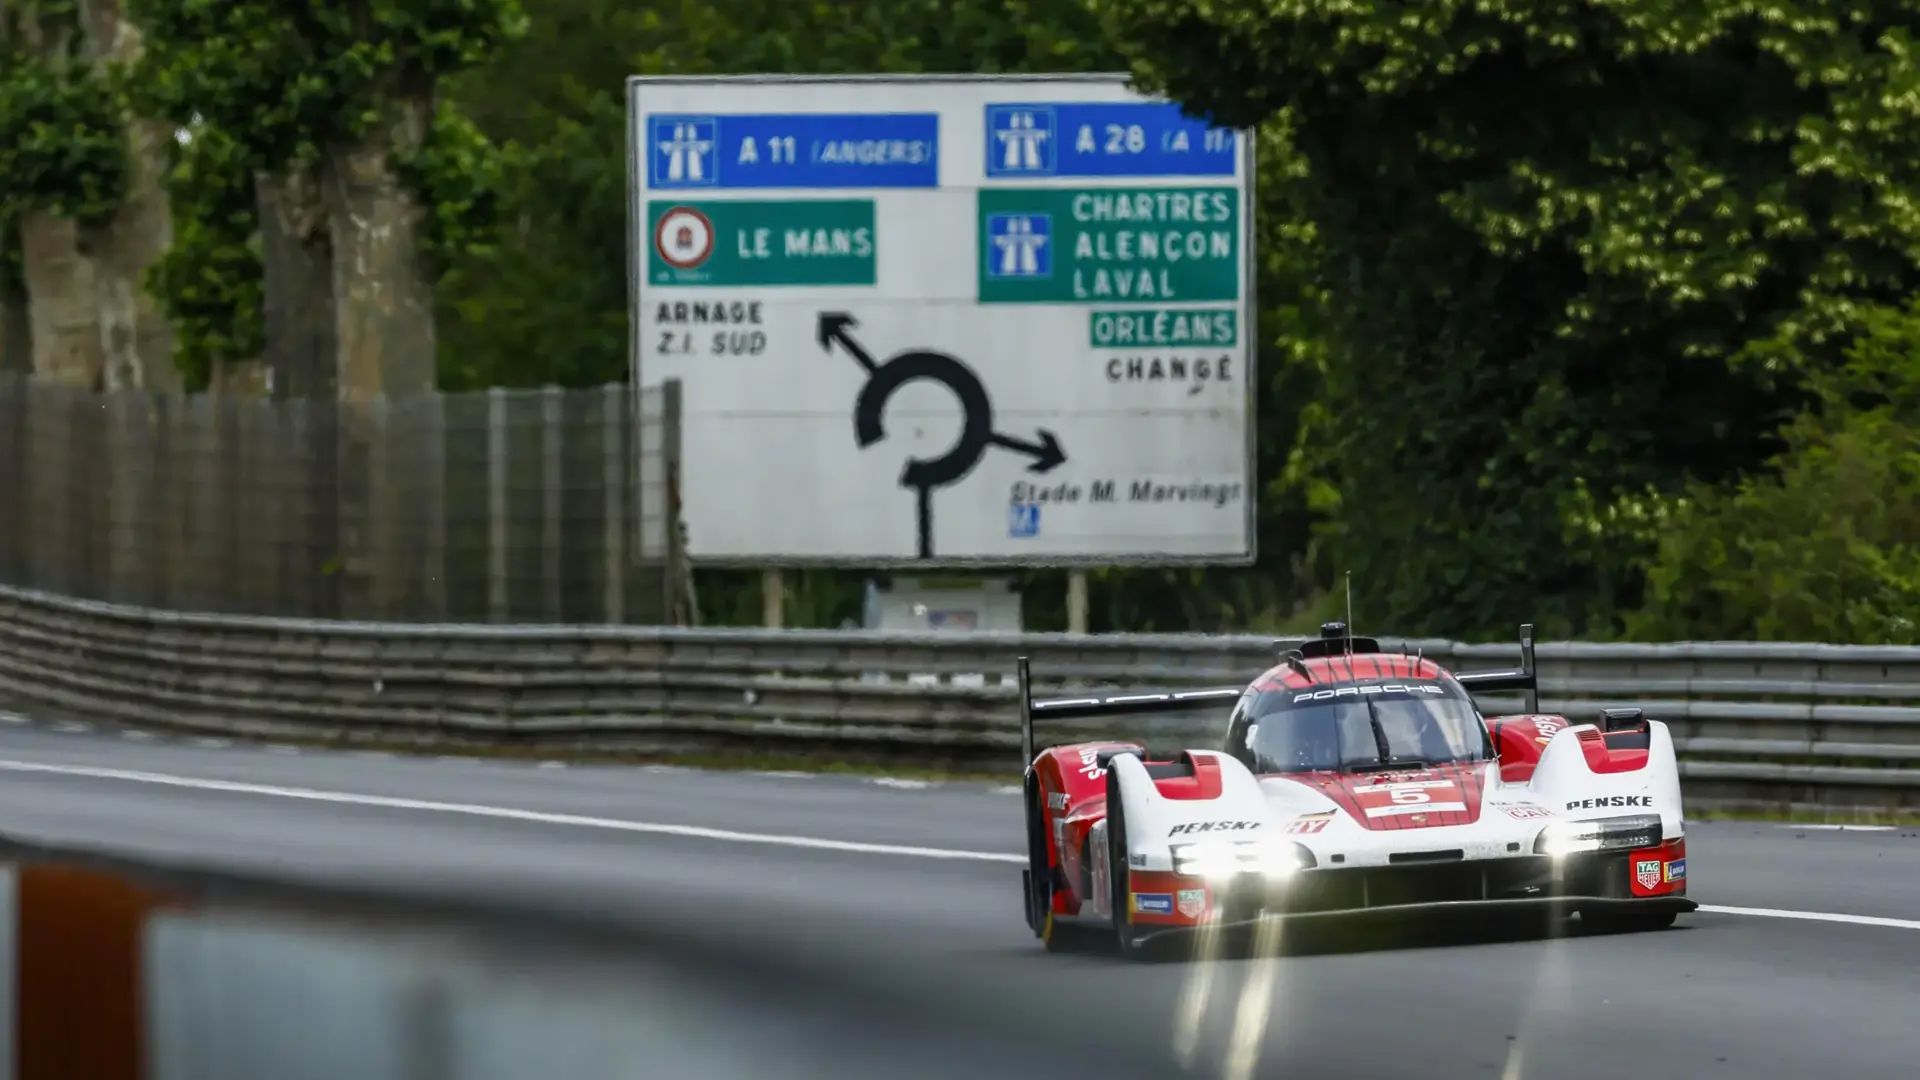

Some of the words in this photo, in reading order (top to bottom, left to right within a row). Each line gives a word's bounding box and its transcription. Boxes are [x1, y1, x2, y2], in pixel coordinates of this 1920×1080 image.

[738, 136, 759, 164] A
[768, 136, 796, 163] 11
[1075, 124, 1096, 153] A
[1104, 124, 1146, 154] 28
[1071, 192, 1231, 221] CHARTRES
[738, 228, 772, 258] LE
[784, 227, 873, 258] MANS
[1075, 230, 1232, 262] ALENÇON
[1073, 268, 1175, 298] LAVAL
[656, 302, 763, 324] ARNAGE
[1094, 311, 1233, 343] ORLÉANS
[711, 331, 768, 356] SUD
[1105, 354, 1232, 382] CHANGÉ
[1294, 685, 1443, 703] PORSCHE
[1390, 788, 1431, 804] 5
[1566, 795, 1653, 810] PENSKE
[1640, 863, 1659, 873] TAG
